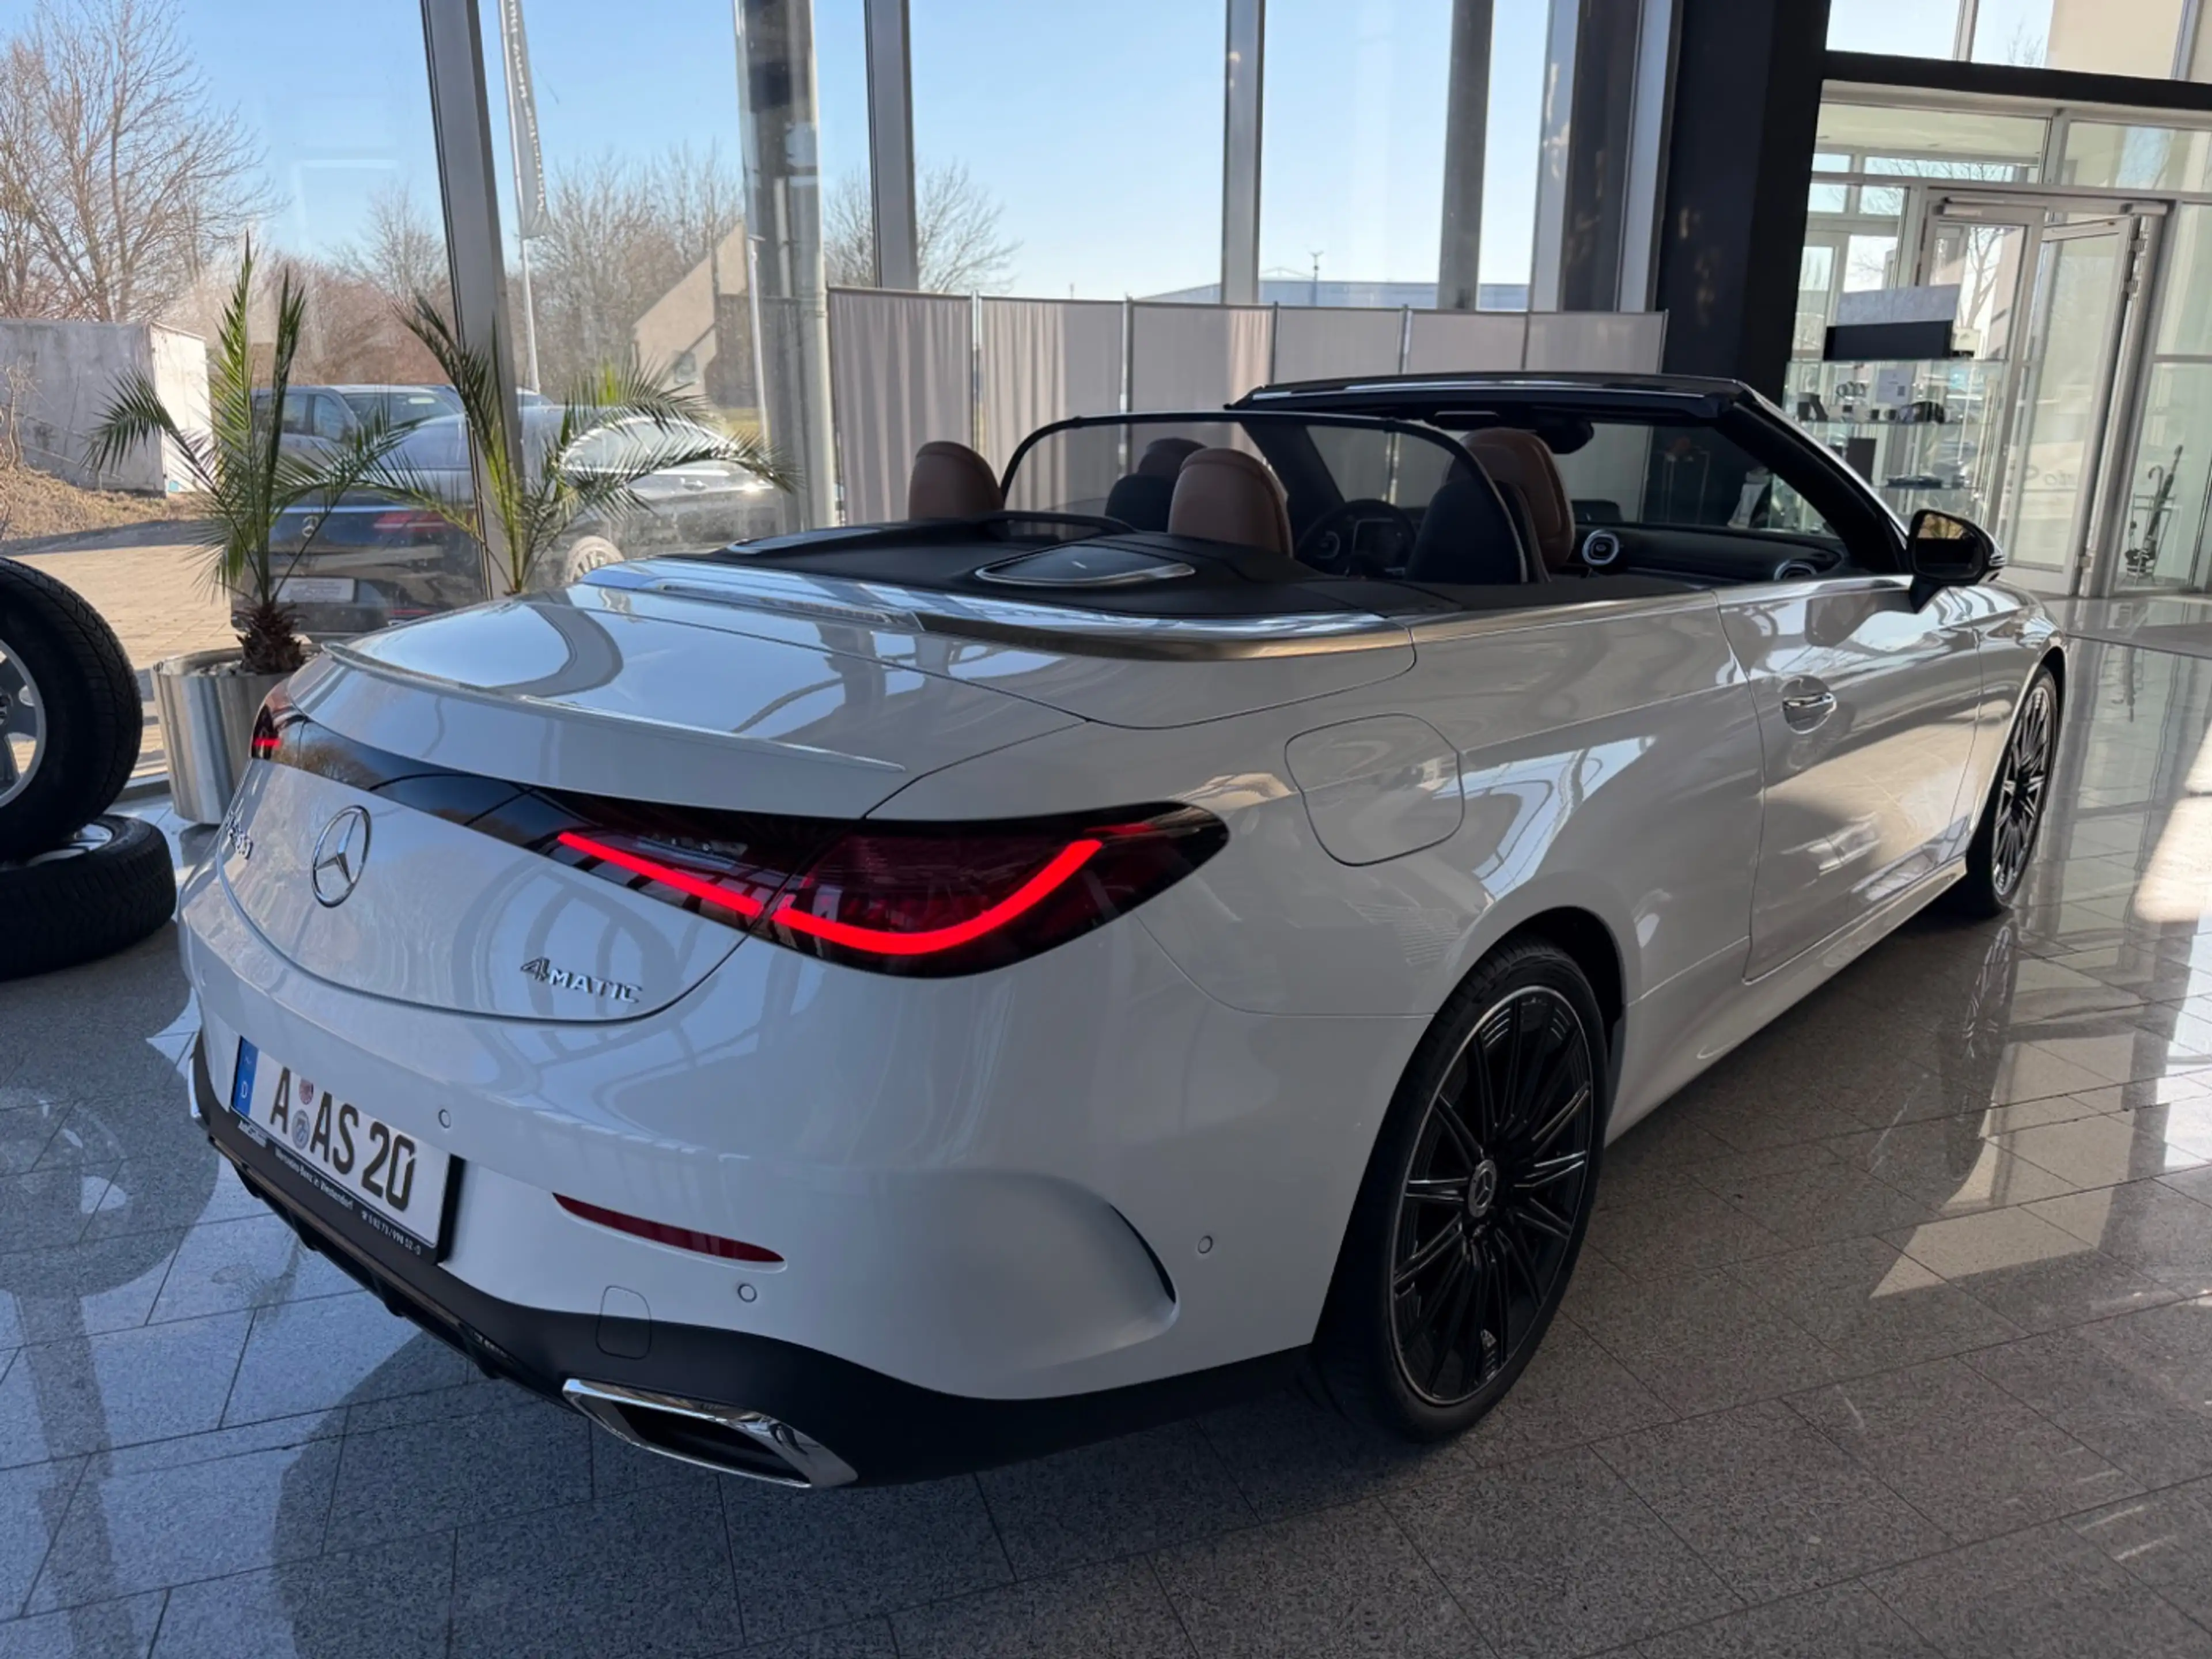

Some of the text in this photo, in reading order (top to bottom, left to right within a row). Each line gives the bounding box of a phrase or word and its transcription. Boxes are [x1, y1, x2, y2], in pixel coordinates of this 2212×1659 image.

[520, 956, 643, 1004] 4MATIC
[241, 1080, 248, 1099] D
[270, 1067, 416, 1213] A AS 20
